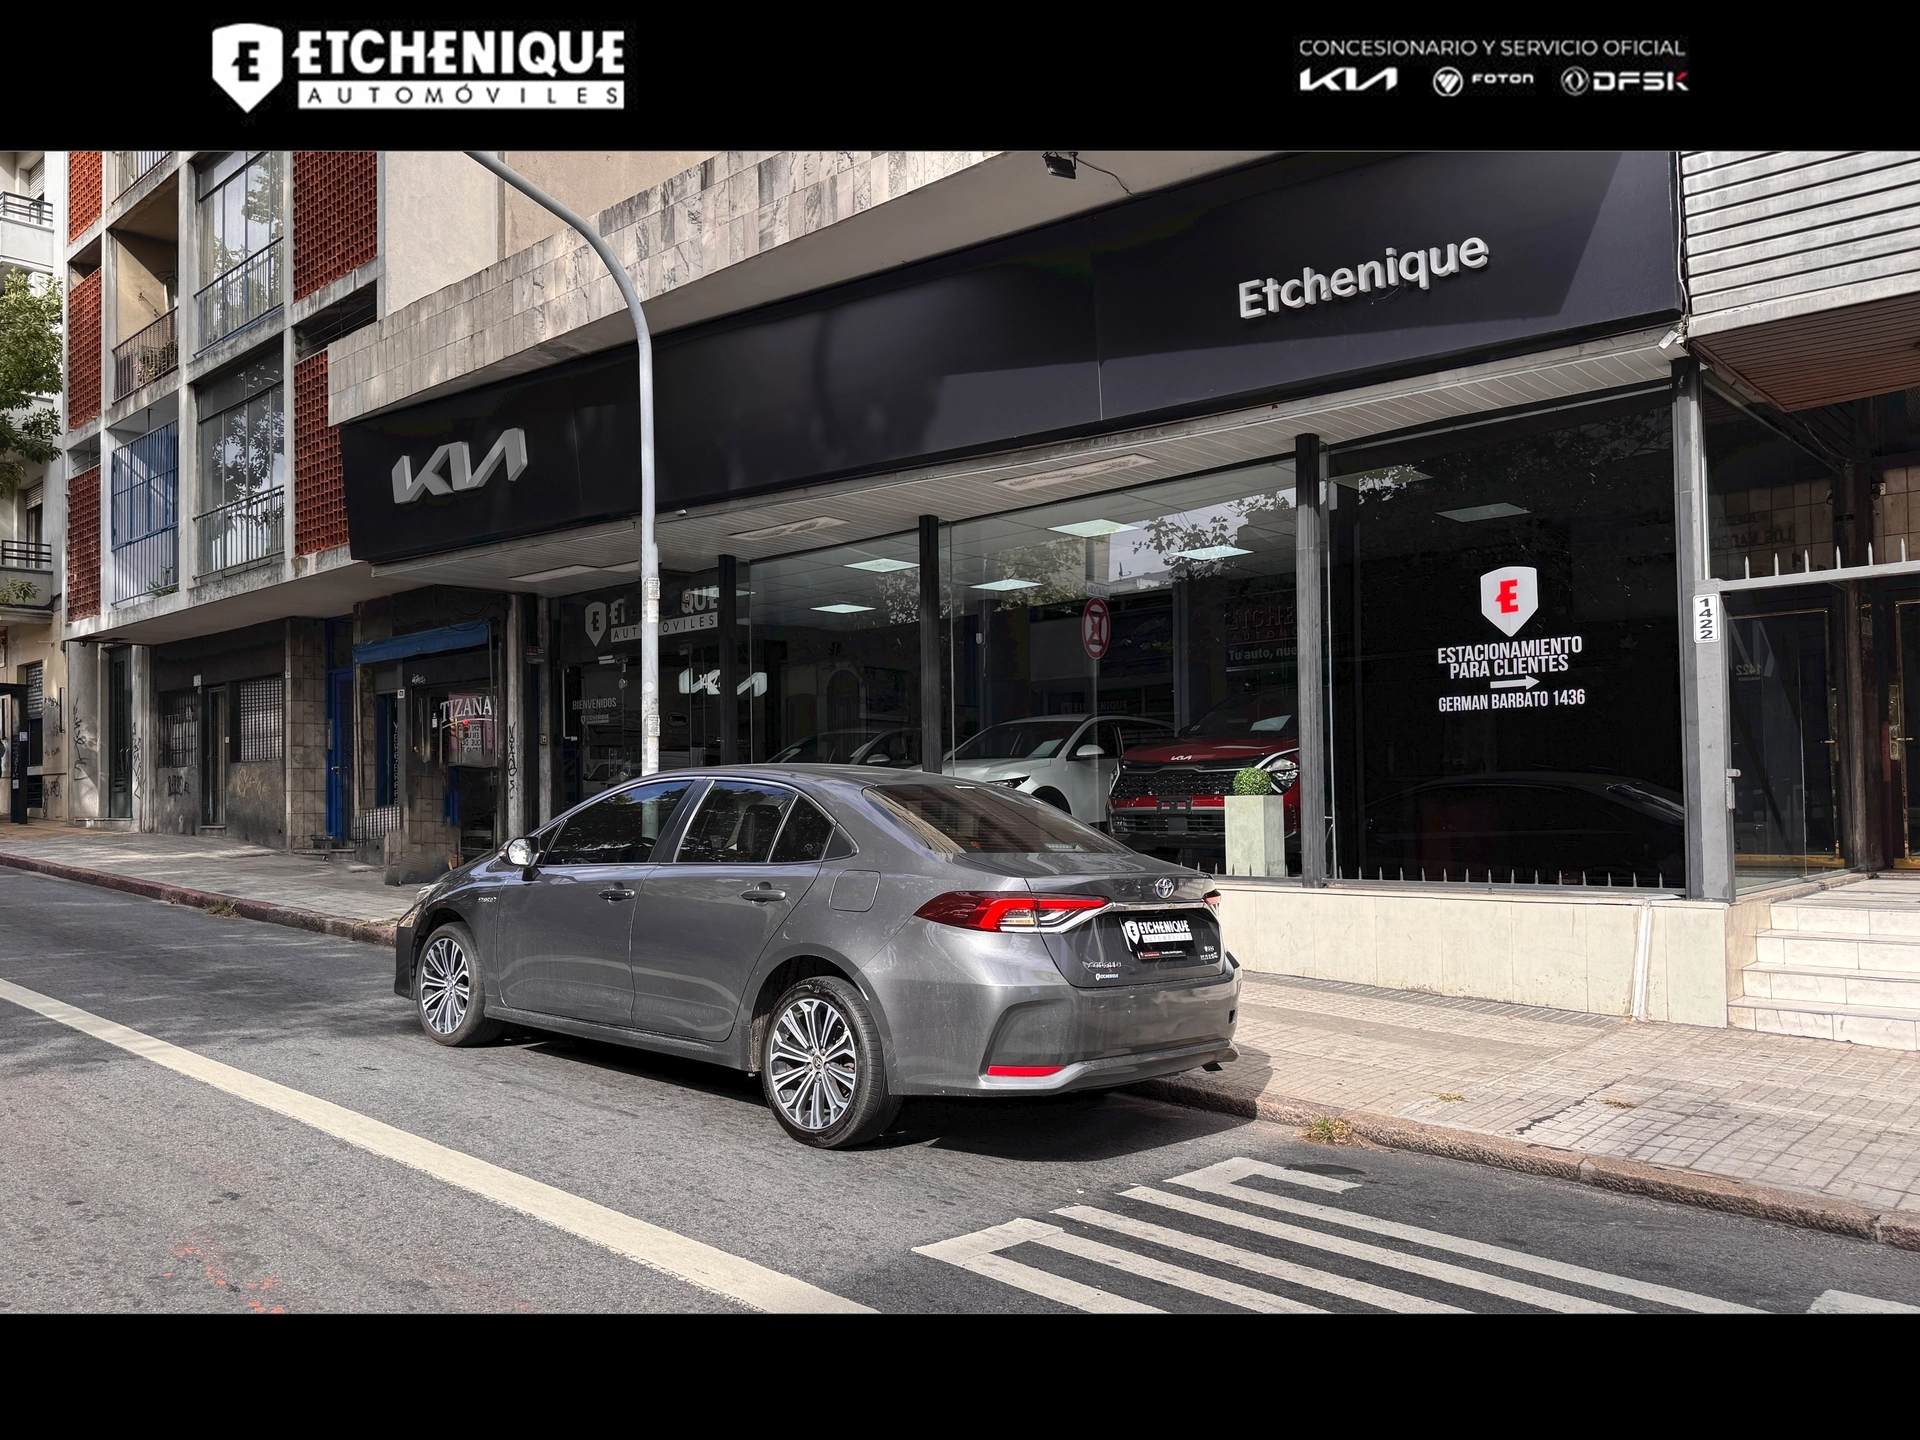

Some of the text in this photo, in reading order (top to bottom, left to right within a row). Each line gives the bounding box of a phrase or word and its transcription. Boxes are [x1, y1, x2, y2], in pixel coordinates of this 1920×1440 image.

[1238, 237, 1489, 319] Etchenique
[391, 427, 528, 504] KIA
[1494, 578, 1519, 614] E
[1699, 597, 1713, 640] 1422
[1229, 650, 1241, 661] Tu
[1275, 646, 1297, 657] nue
[1437, 635, 1583, 664] ESTACIONAMIENTO
[1450, 653, 1569, 680] PARA CLIENTES
[679, 667, 767, 697] KA
[440, 695, 493, 723] TIZANA
[572, 697, 617, 710] BIENVENIDOS
[1438, 688, 1586, 712] GERMAN BARBATO 1436
[1138, 920, 1190, 935] ETCHENIQUE
